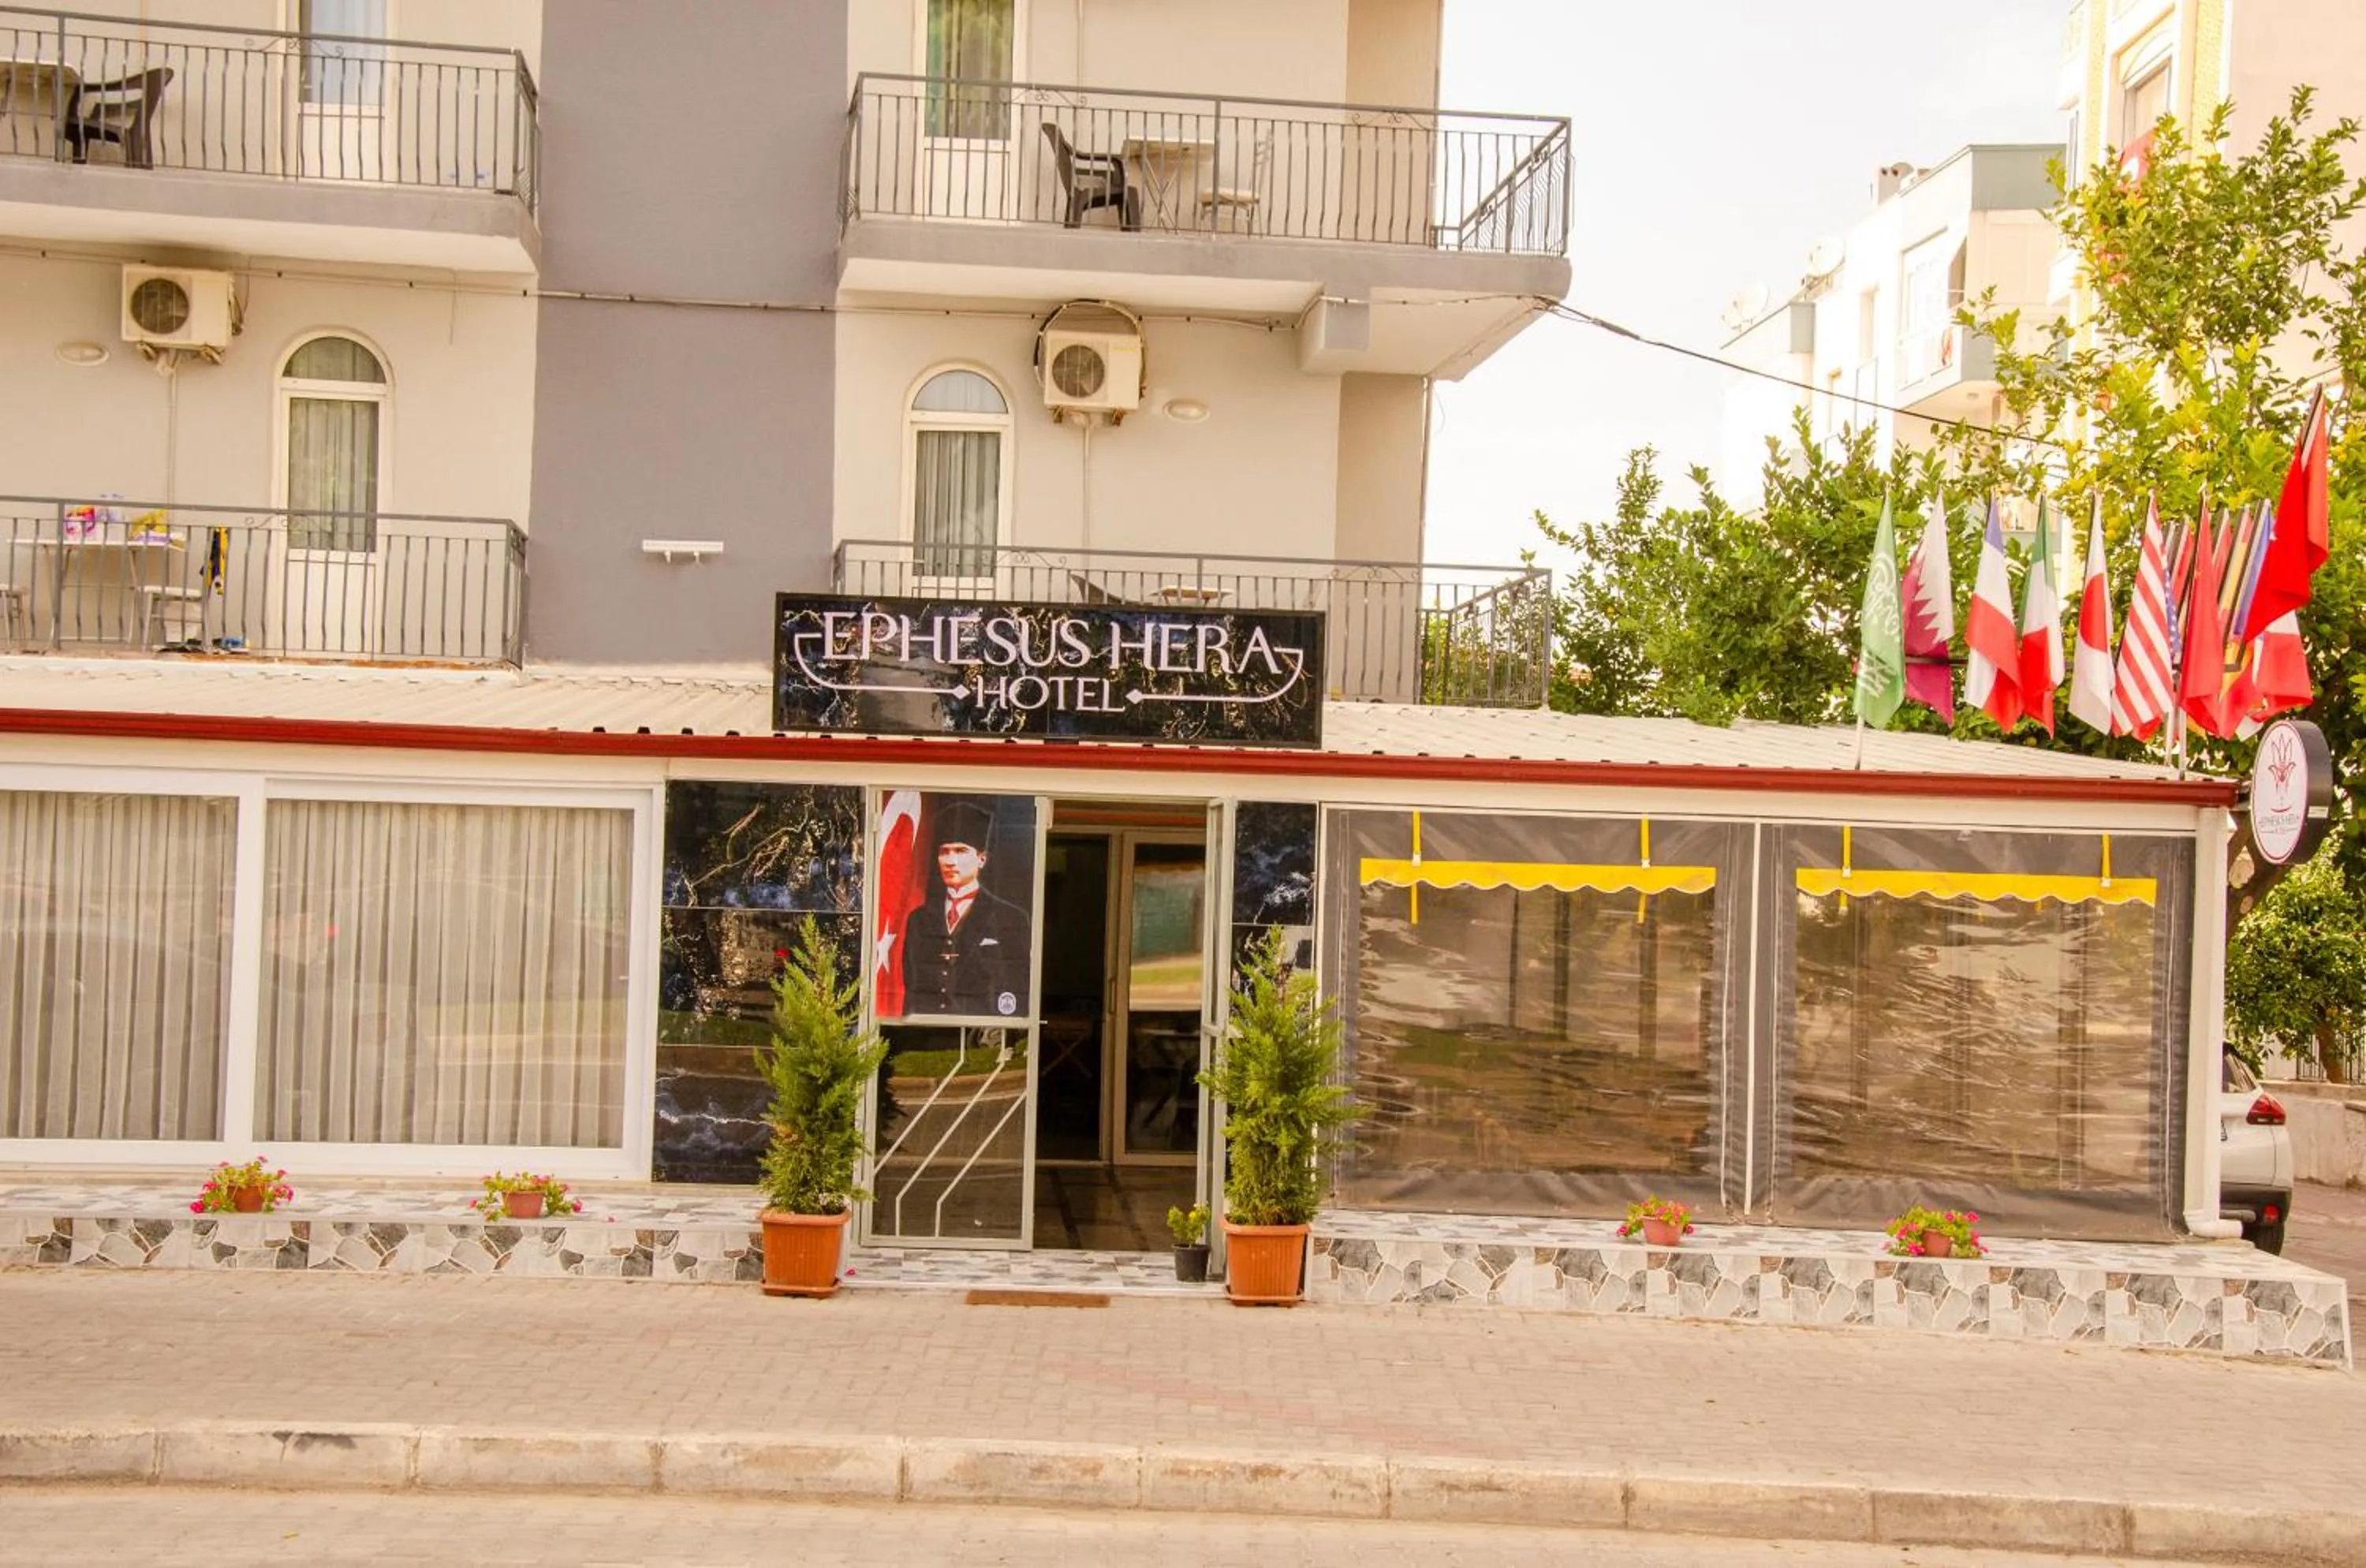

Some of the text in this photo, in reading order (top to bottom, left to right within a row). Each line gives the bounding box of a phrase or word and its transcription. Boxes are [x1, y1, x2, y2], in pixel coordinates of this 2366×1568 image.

[823, 610, 1282, 675] EPHESUS HERA
[976, 674, 1125, 712] HOTEL
